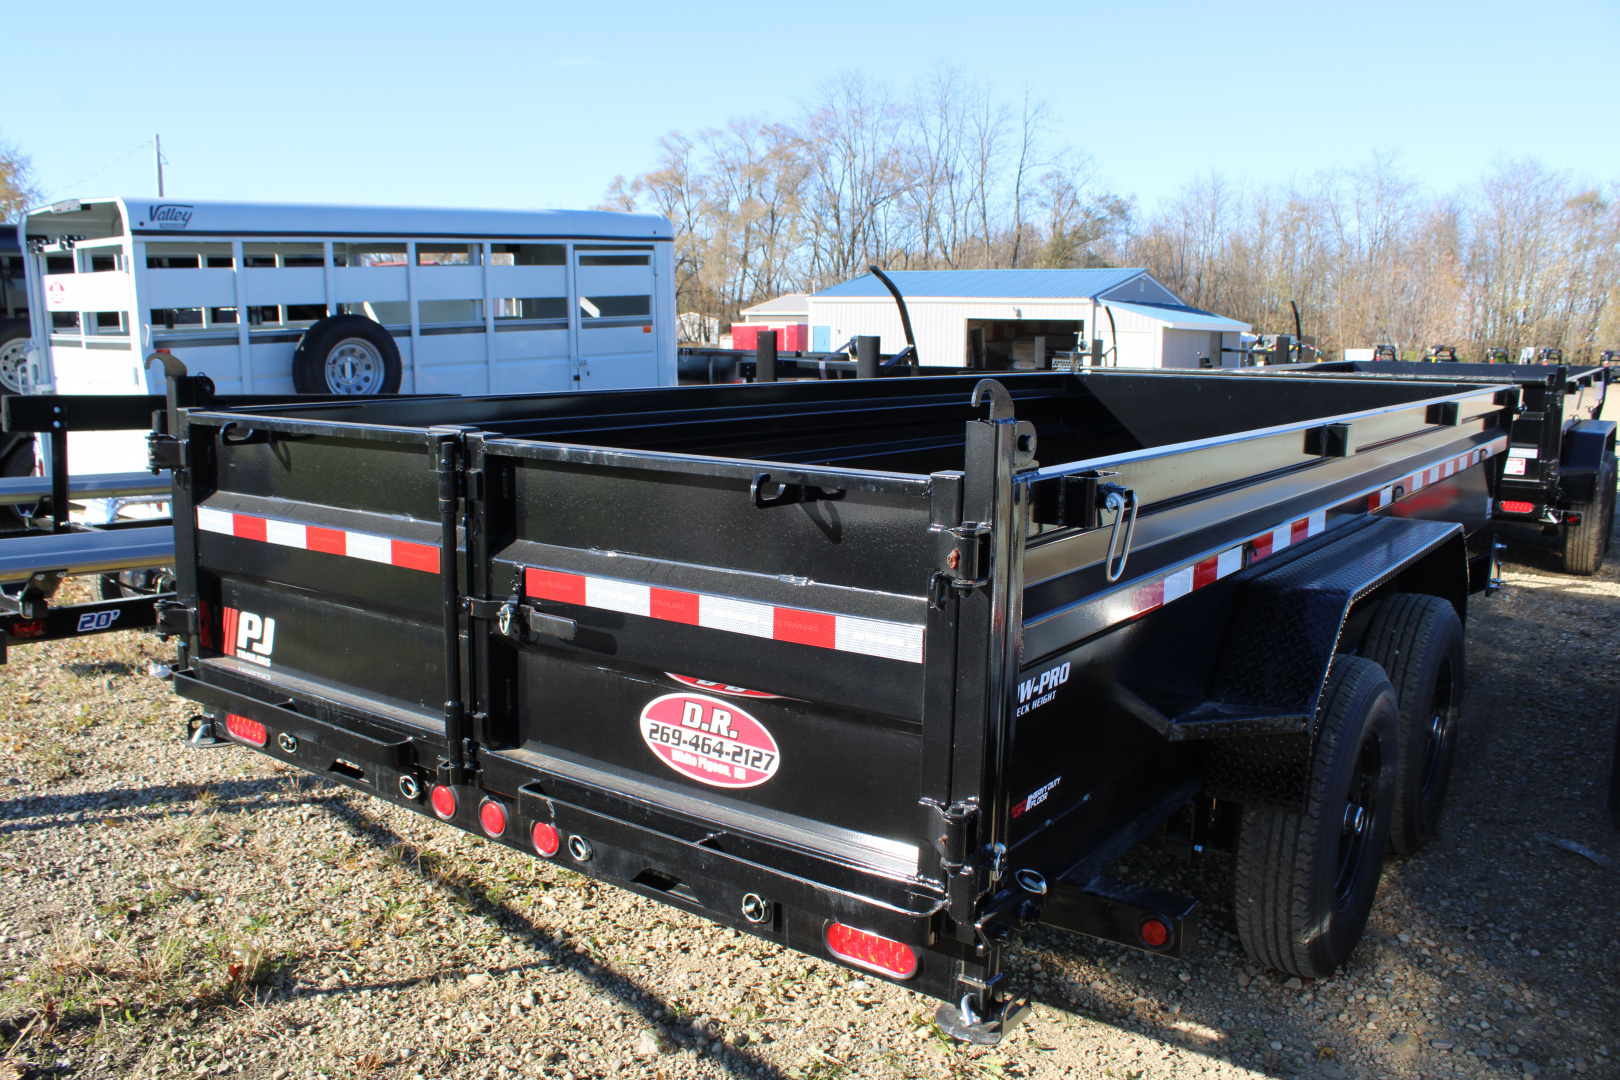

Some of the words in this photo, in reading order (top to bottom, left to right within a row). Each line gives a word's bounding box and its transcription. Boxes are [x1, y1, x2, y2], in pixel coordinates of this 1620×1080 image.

[149, 203, 194, 229] Valley
[237, 611, 275, 655] PJ
[236, 649, 271, 667] TRAILERS
[1017, 661, 1071, 704] W-PRO
[1031, 689, 1057, 710] HEIGHT
[680, 700, 739, 740] D.R.
[648, 722, 776, 771] 269-464-2127
[671, 748, 698, 767] White
[698, 756, 731, 778] Pigeon,
[733, 767, 746, 781] MI
[1031, 792, 1048, 808] FLOOR
